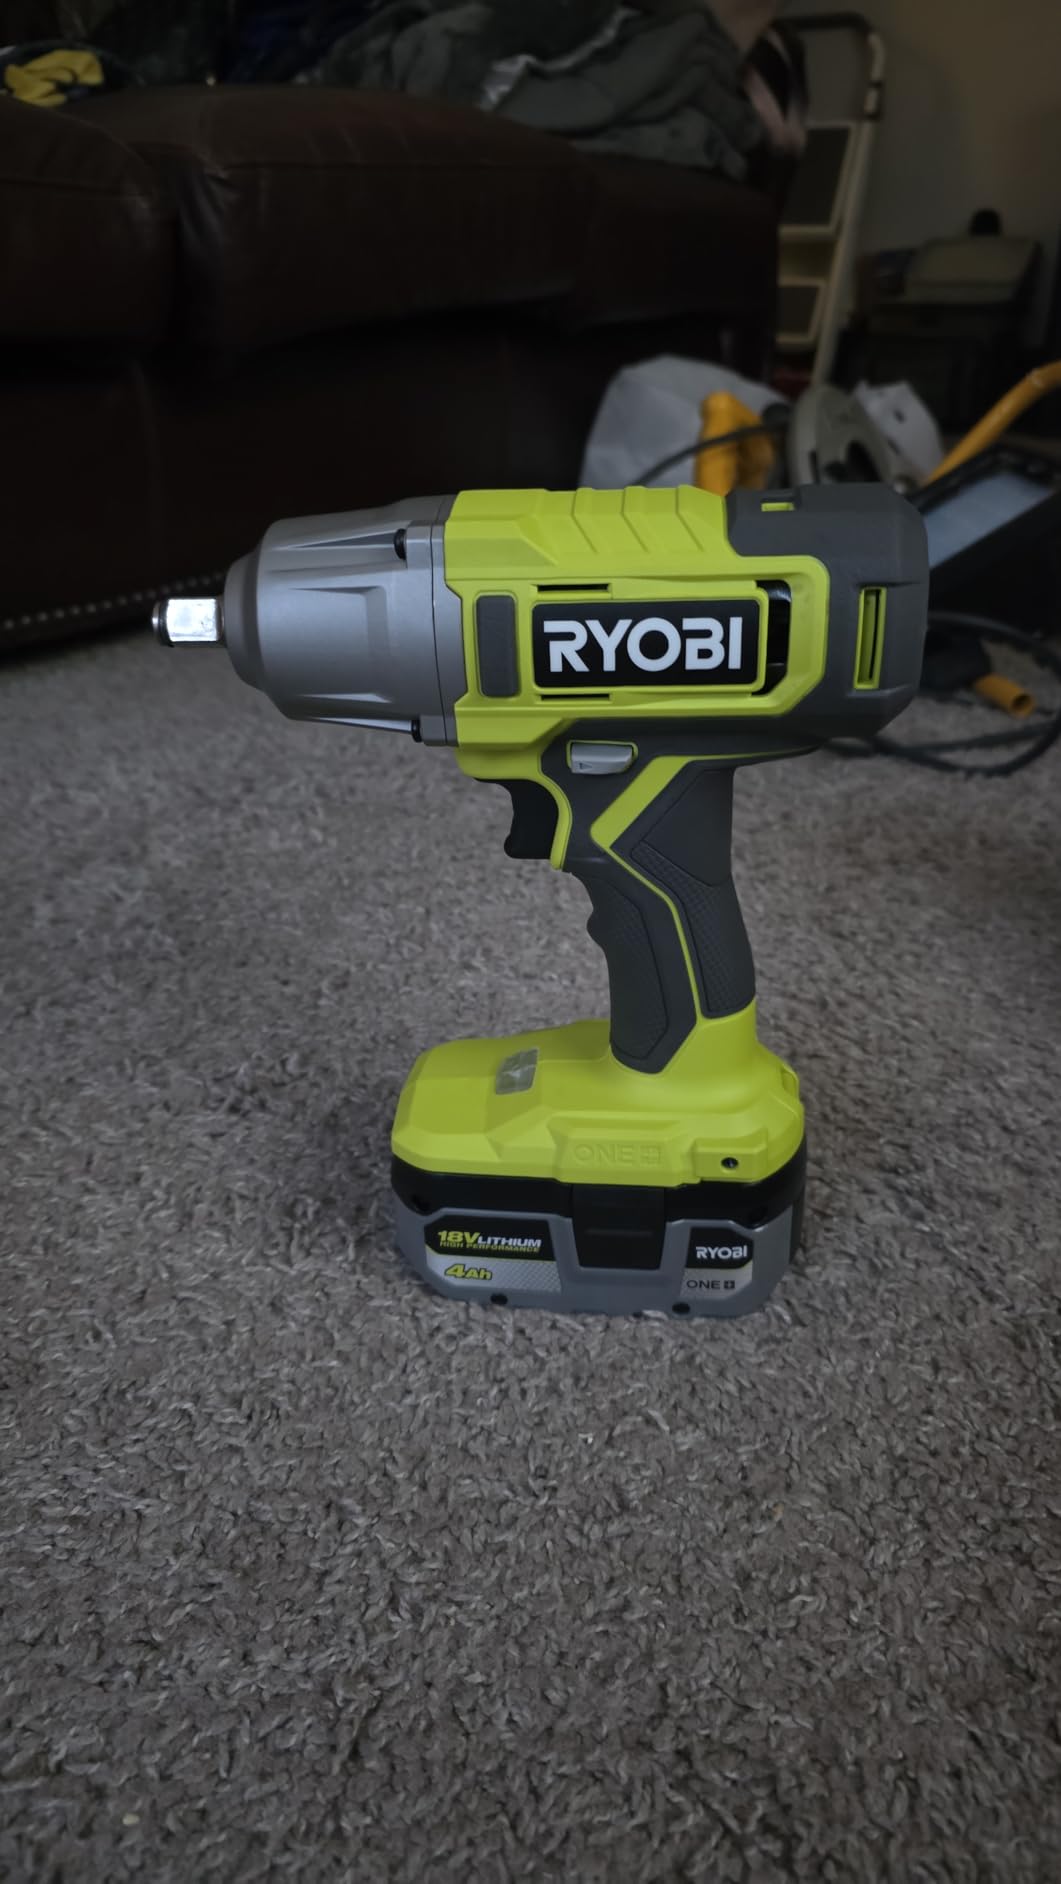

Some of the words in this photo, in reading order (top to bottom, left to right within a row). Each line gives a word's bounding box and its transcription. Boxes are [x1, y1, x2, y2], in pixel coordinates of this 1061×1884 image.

[543, 616, 743, 673] RYOBI
[440, 1241, 464, 1249] HIGH
[466, 1243, 540, 1253] PERFORMANCE
[696, 1245, 748, 1260] RYOBI
[444, 1263, 493, 1281] 4Ah
